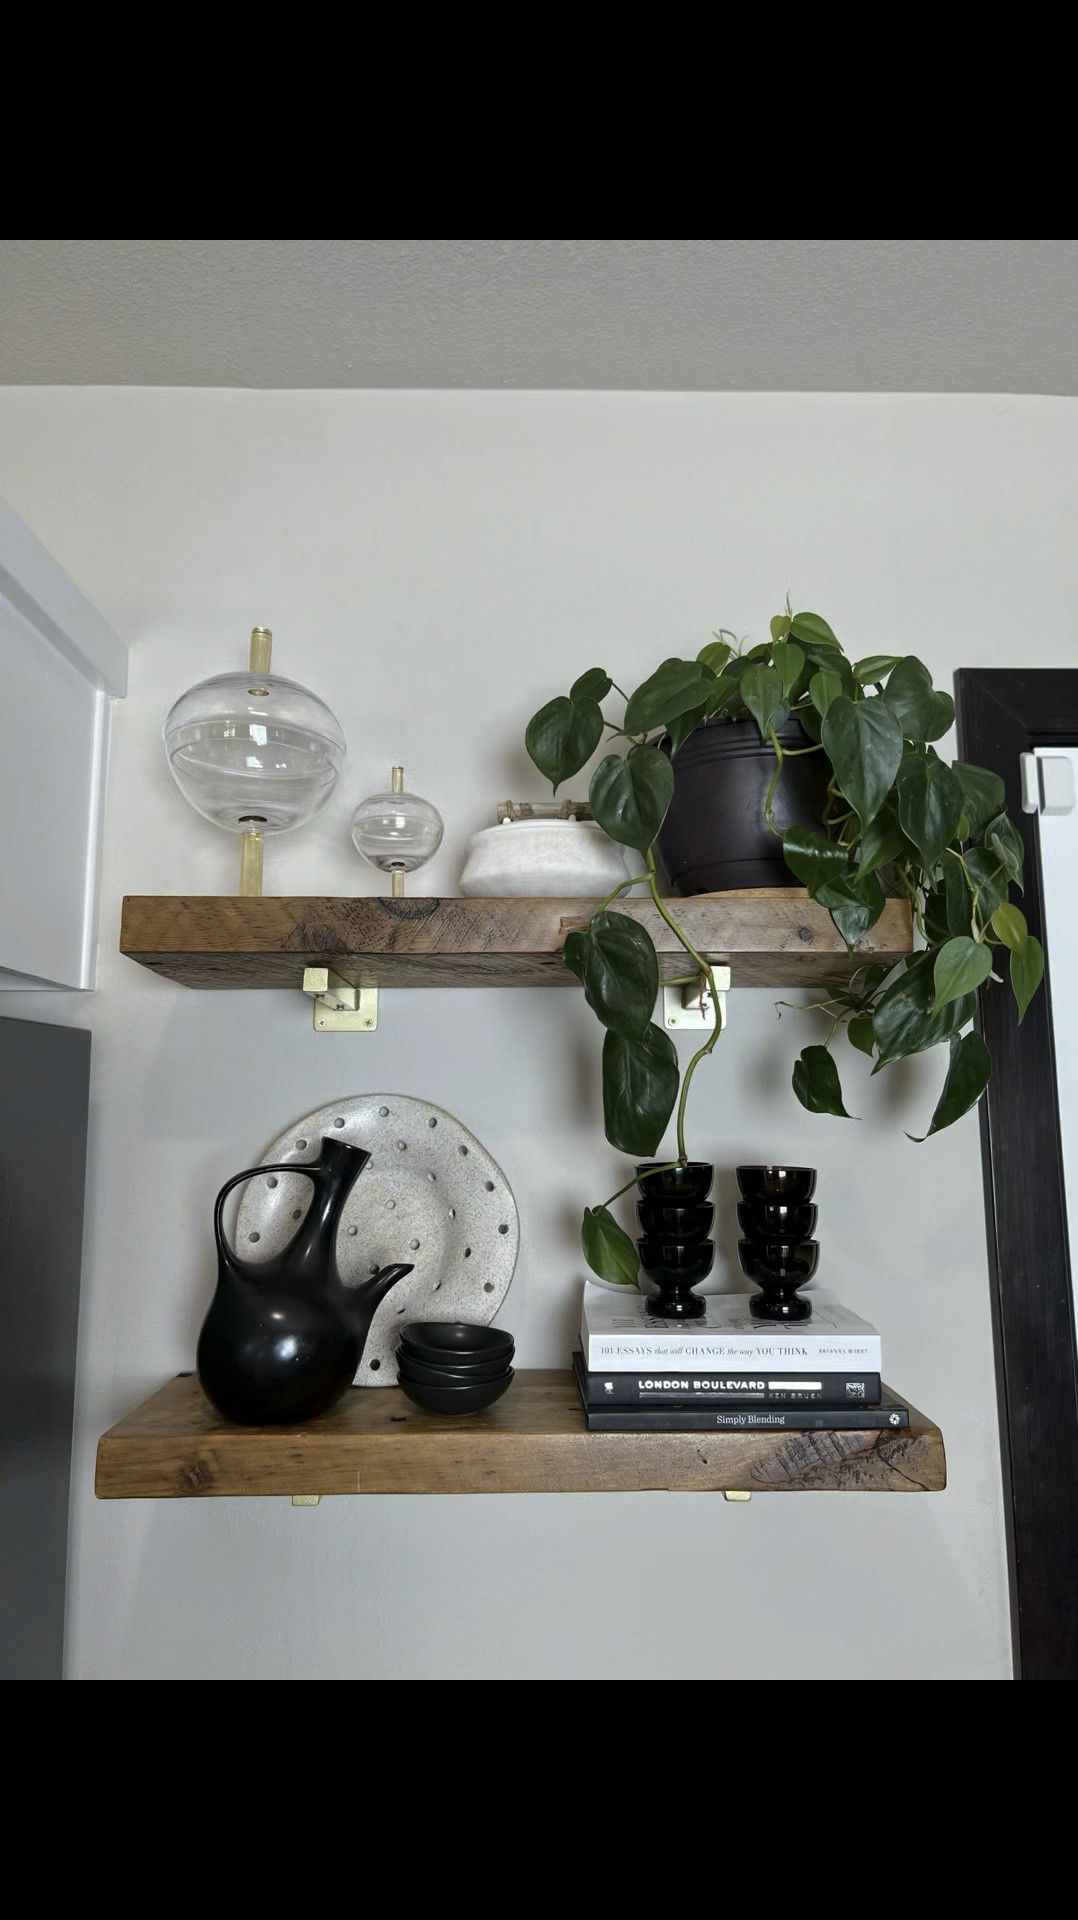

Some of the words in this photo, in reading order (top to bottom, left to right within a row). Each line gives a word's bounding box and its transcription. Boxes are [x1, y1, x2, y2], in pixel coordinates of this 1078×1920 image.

[601, 1347, 613, 1355] 101
[617, 1347, 652, 1355] ESSAYS
[654, 1346, 669, 1355] that
[670, 1346, 683, 1355] will
[685, 1346, 725, 1355] CHANGE
[727, 1347, 739, 1355] the
[739, 1349, 754, 1357] way
[756, 1347, 775, 1355] YOU
[777, 1347, 808, 1355] THINK
[638, 1380, 689, 1390] LONDON
[693, 1380, 765, 1390] BOULEVARD
[716, 1414, 746, 1426] Simply
[748, 1414, 785, 1426] Blending
